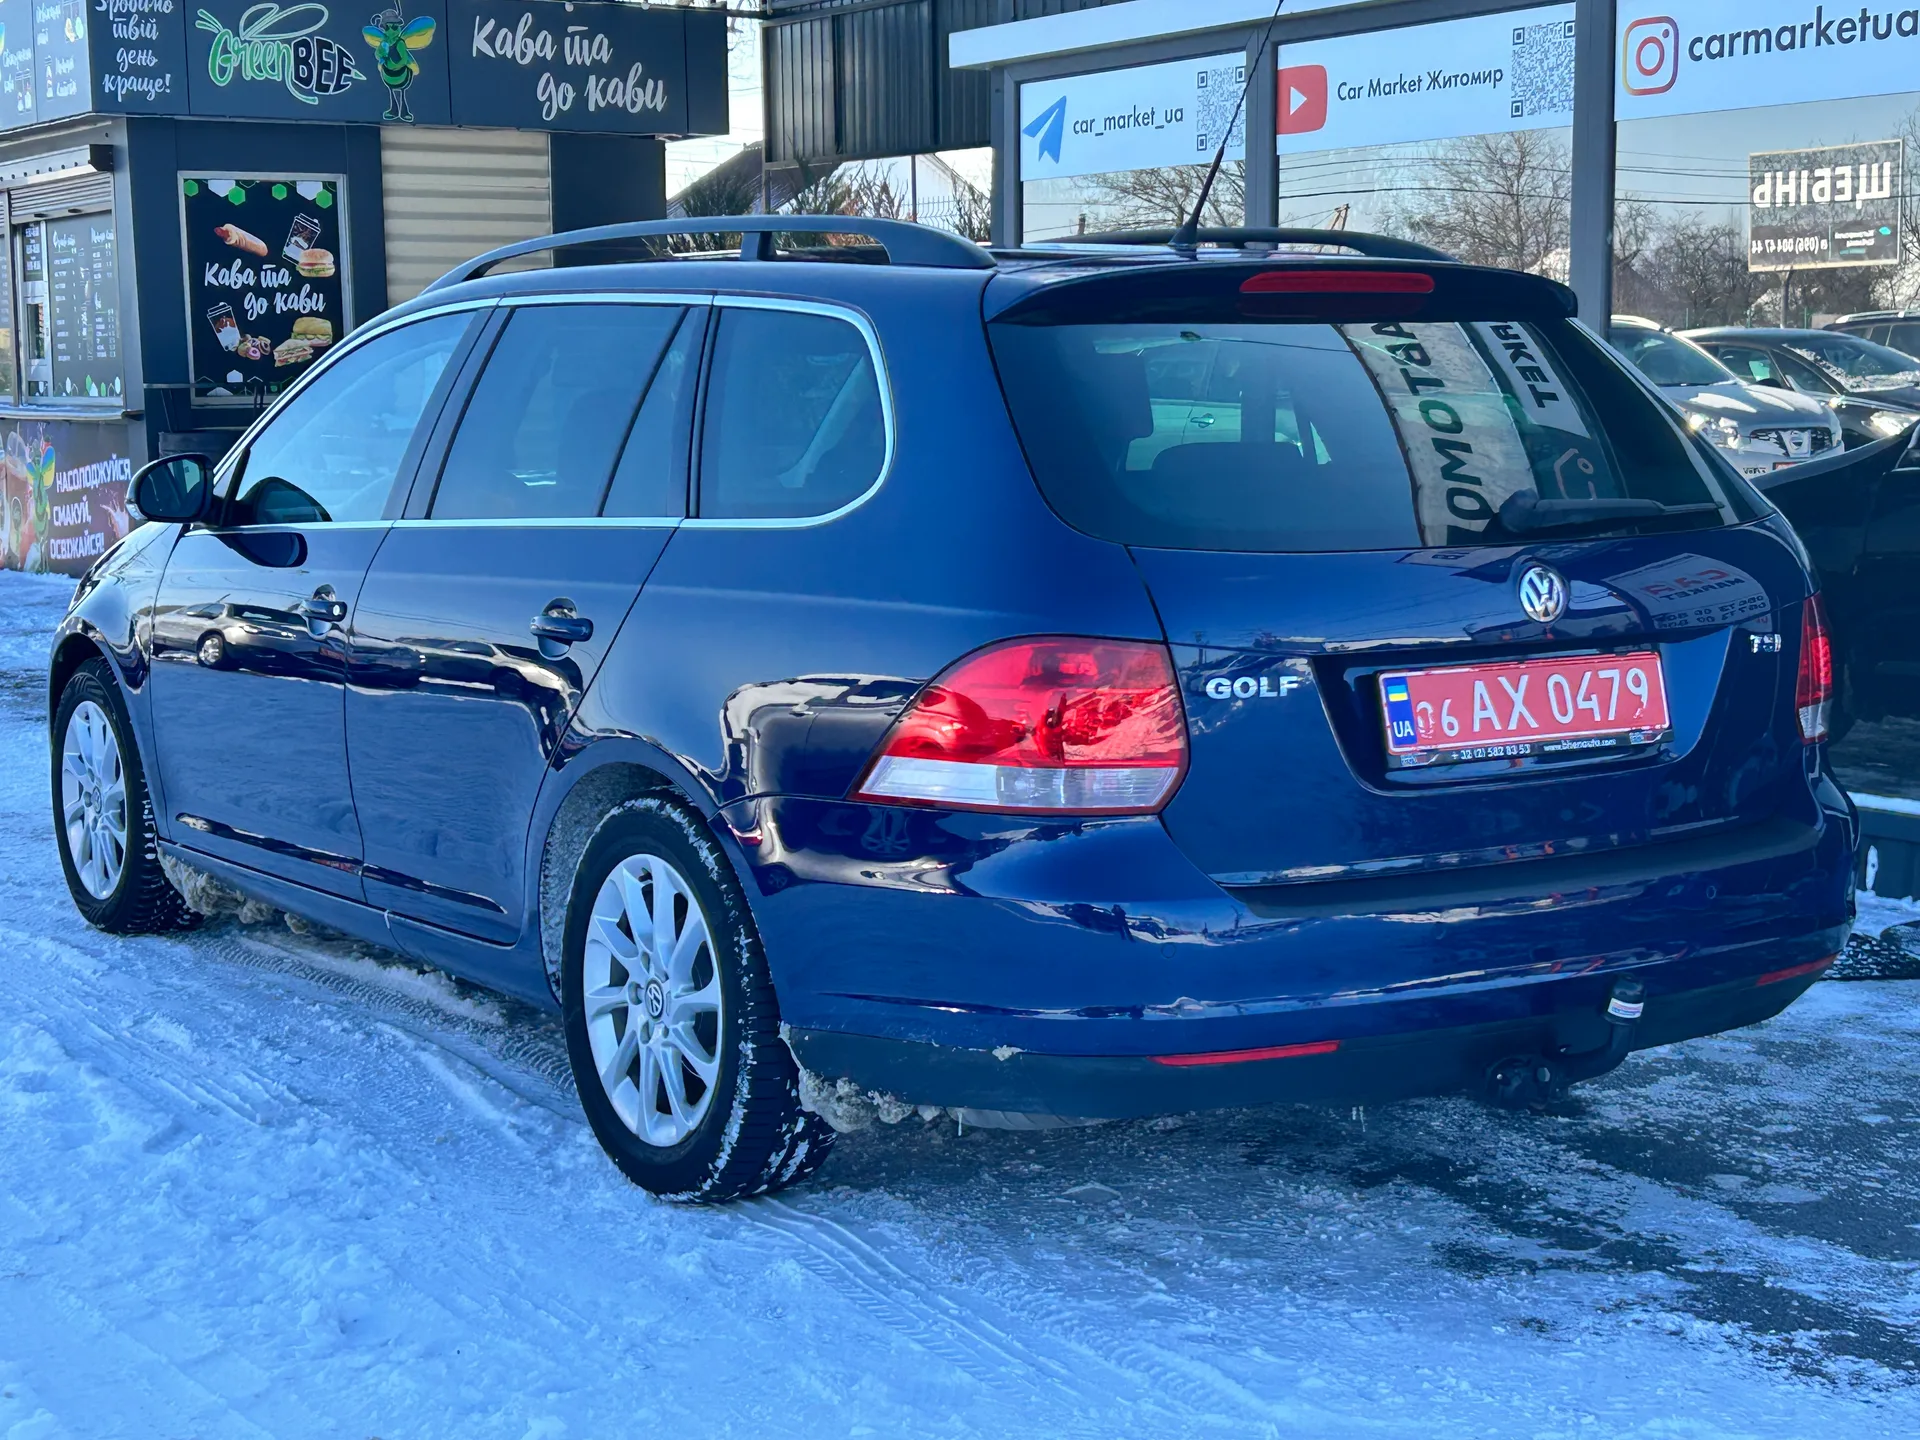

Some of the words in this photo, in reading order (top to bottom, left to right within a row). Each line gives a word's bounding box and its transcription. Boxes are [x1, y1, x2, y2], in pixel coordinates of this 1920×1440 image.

[113, 14, 159, 40] твій
[472, 12, 557, 65] Кава
[564, 25, 613, 66] та
[1688, 5, 1919, 62] carmarketua
[116, 47, 158, 73] день
[102, 73, 172, 102] краще!
[536, 72, 576, 121] до
[584, 62, 667, 113] кави
[1337, 82, 1362, 101] Car
[1368, 72, 1422, 98] Market
[1426, 67, 1503, 91] Житомир
[1072, 105, 1184, 137] car_market_ua
[204, 258, 256, 290] Кава
[260, 264, 292, 288] та
[244, 291, 269, 320] до
[274, 283, 326, 315] кави
[56, 453, 132, 493] НАСОЛОДЖУЙСЯ
[53, 495, 92, 527] СМАКУЙ,
[1205, 676, 1299, 700] GOLF
[1472, 674, 1540, 732] AX
[1547, 667, 1648, 725] 0479
[1393, 720, 1415, 738] UA
